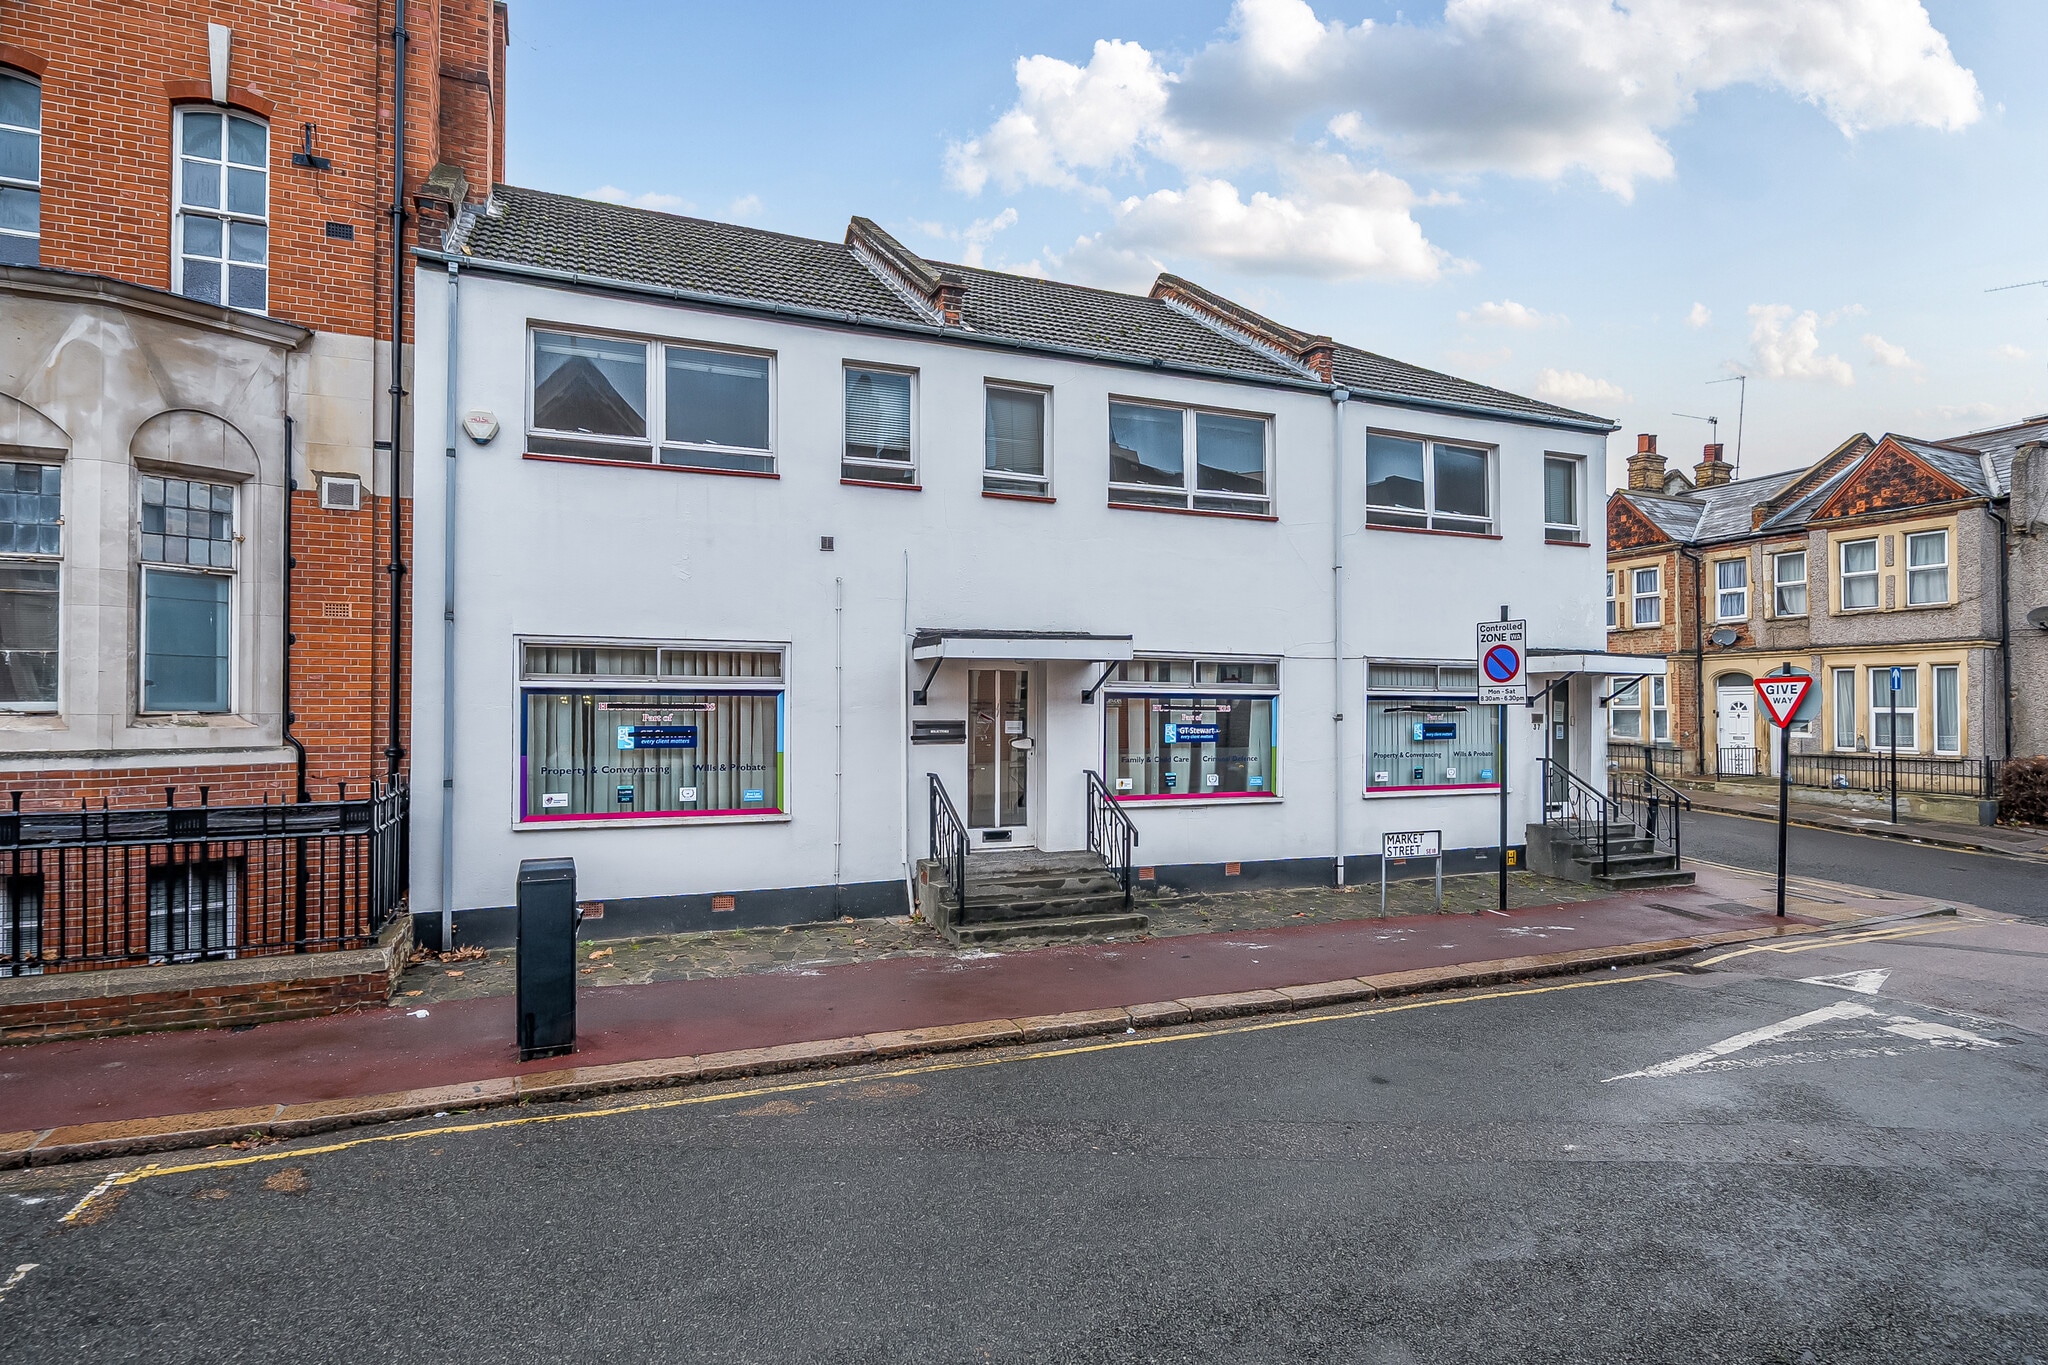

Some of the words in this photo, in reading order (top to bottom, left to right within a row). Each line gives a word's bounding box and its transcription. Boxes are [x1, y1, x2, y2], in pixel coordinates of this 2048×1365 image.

[1480, 622, 1522, 632] Controlled
[1480, 633, 1507, 642] ZONE
[1765, 684, 1798, 695] GIVE
[642, 713, 661, 722] Part
[662, 713, 674, 722] of
[1121, 756, 1145, 764] Family
[1373, 752, 1398, 760] Property
[1405, 751, 1441, 759] Conveyancing
[541, 766, 587, 777] Property
[591, 766, 598, 774] &
[602, 764, 670, 776] Conveyancing
[692, 763, 717, 772] Wills
[729, 763, 767, 771] Probate
[1386, 833, 1424, 845] MARKET
[1386, 845, 1421, 857] STREET
